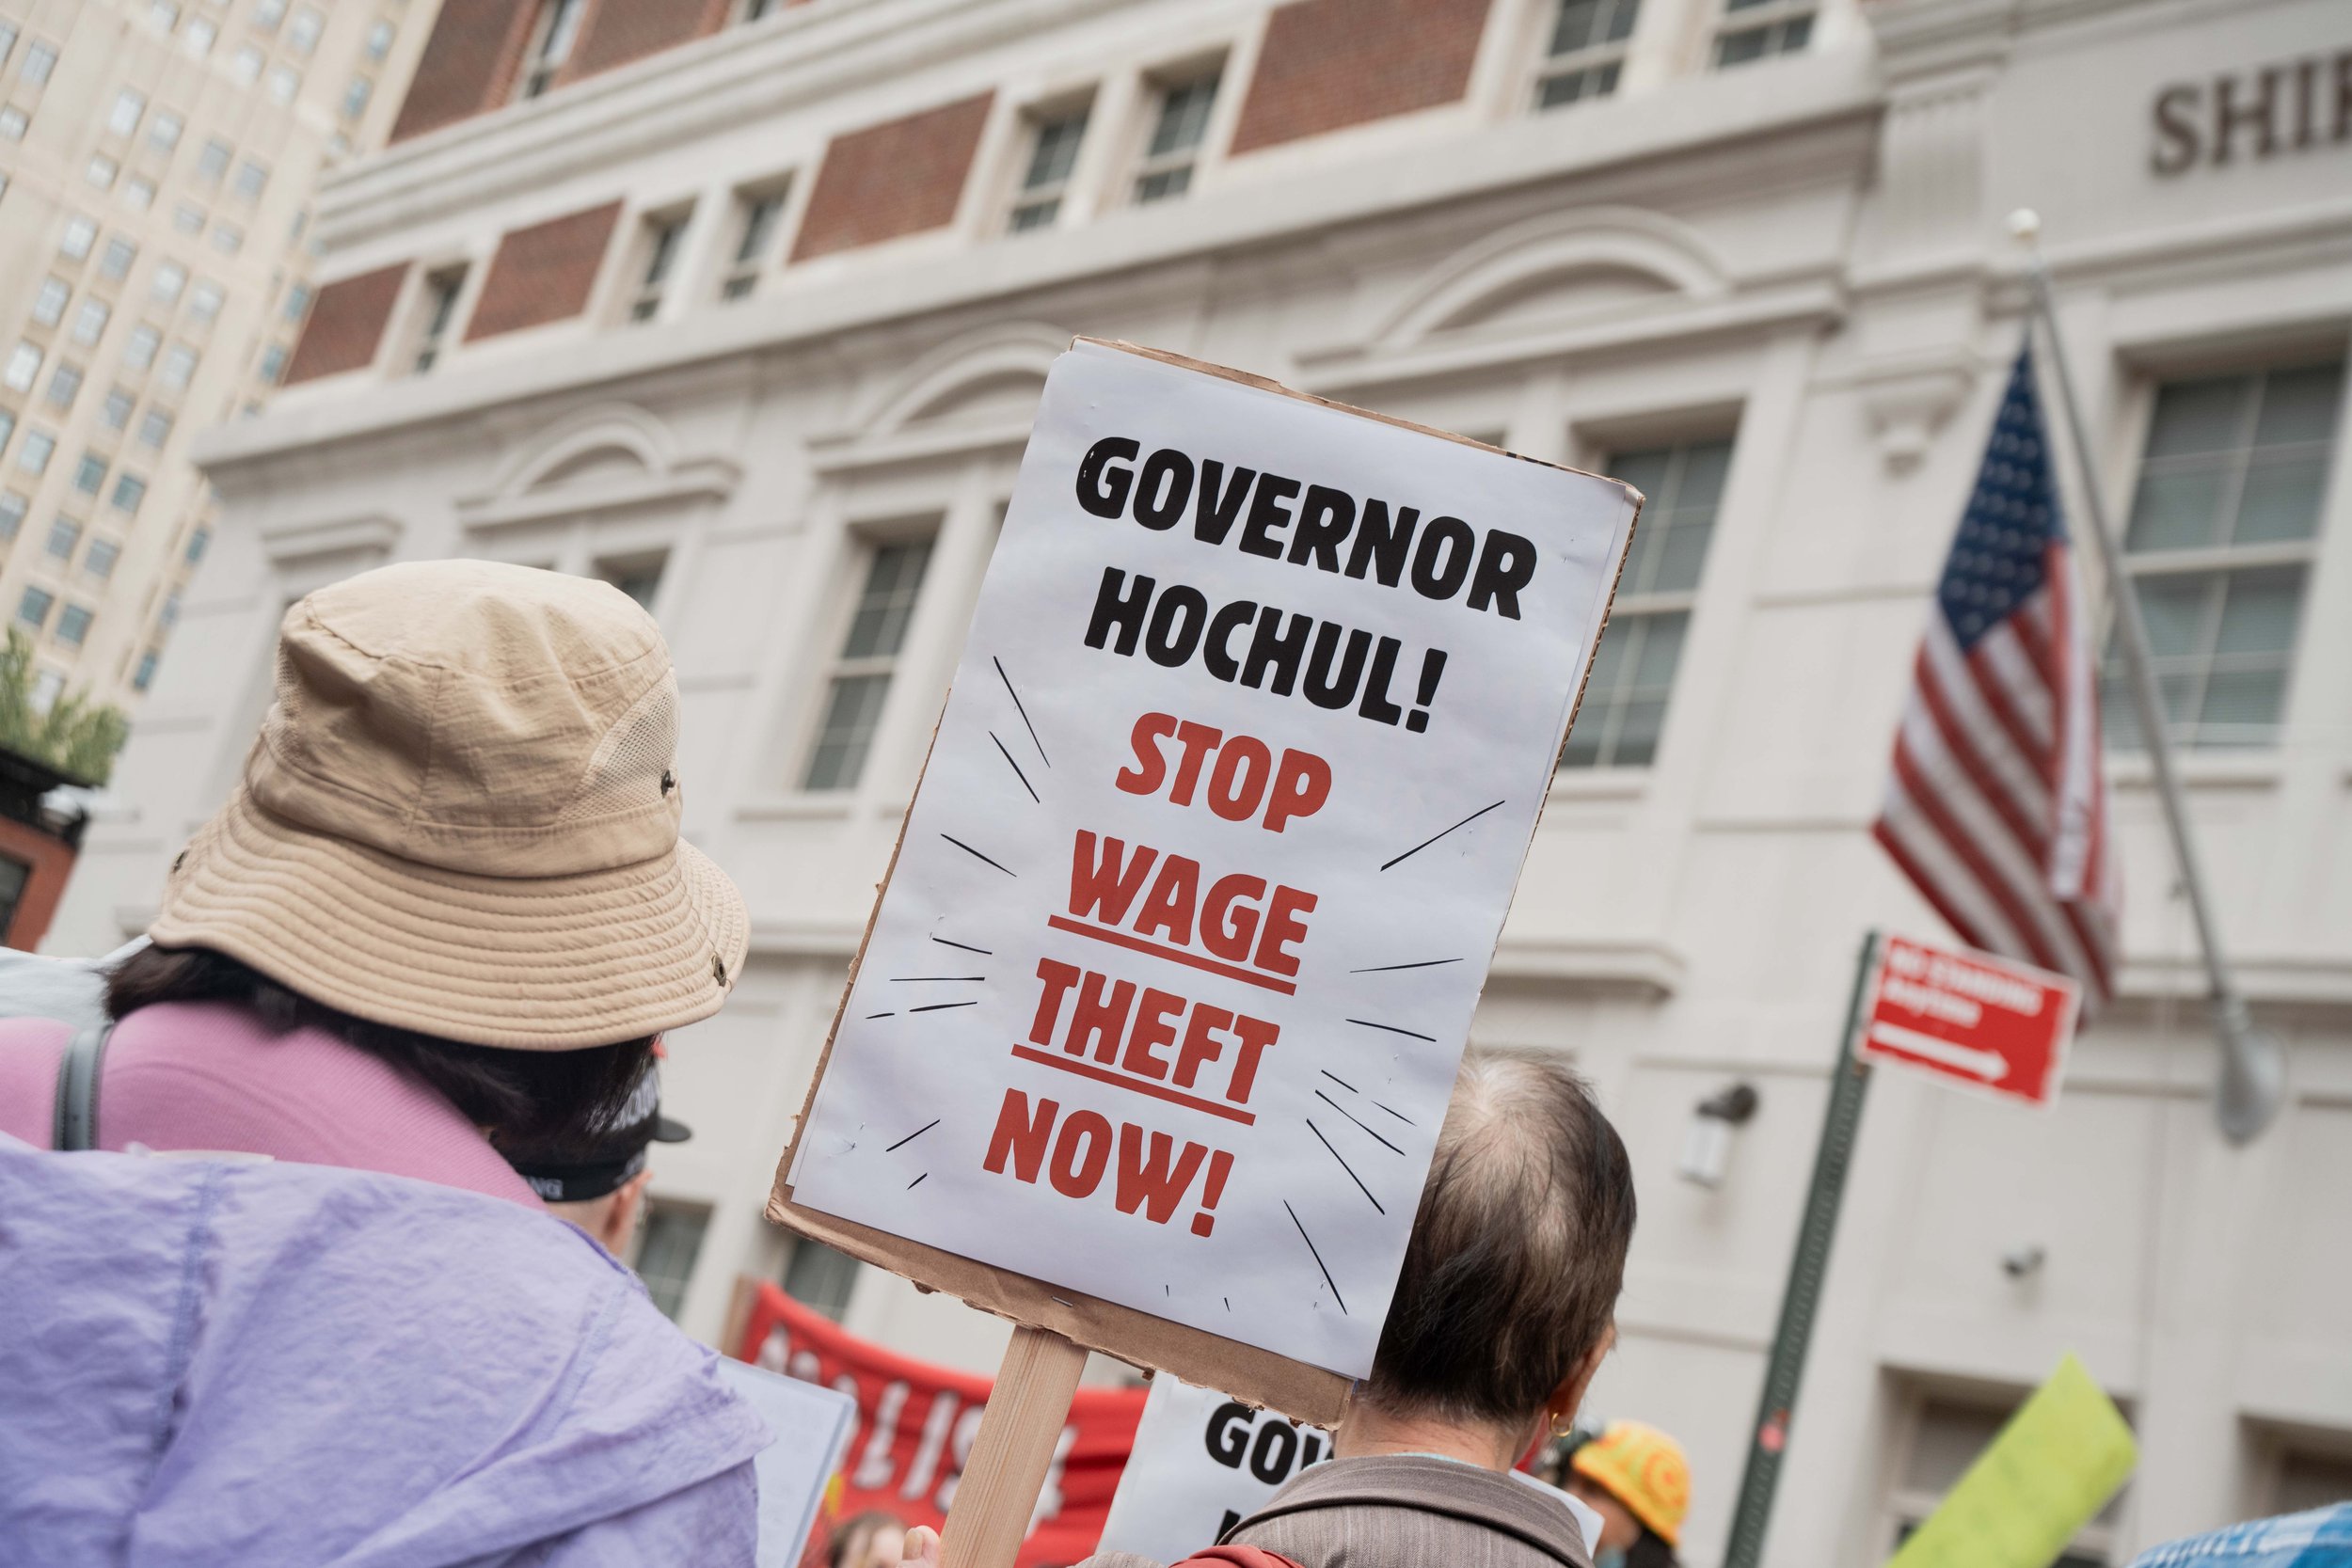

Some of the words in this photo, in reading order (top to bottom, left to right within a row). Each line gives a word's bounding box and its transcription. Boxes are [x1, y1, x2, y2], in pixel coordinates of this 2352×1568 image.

[1075, 436, 1537, 621] GOVERNOR
[1084, 565, 1448, 734] HOCHUL!
[1115, 712, 1331, 833] STOP
[1069, 829, 1318, 977] WAGE
[1028, 958, 1280, 1104] THEFT
[983, 1087, 1234, 1238] NOW!
